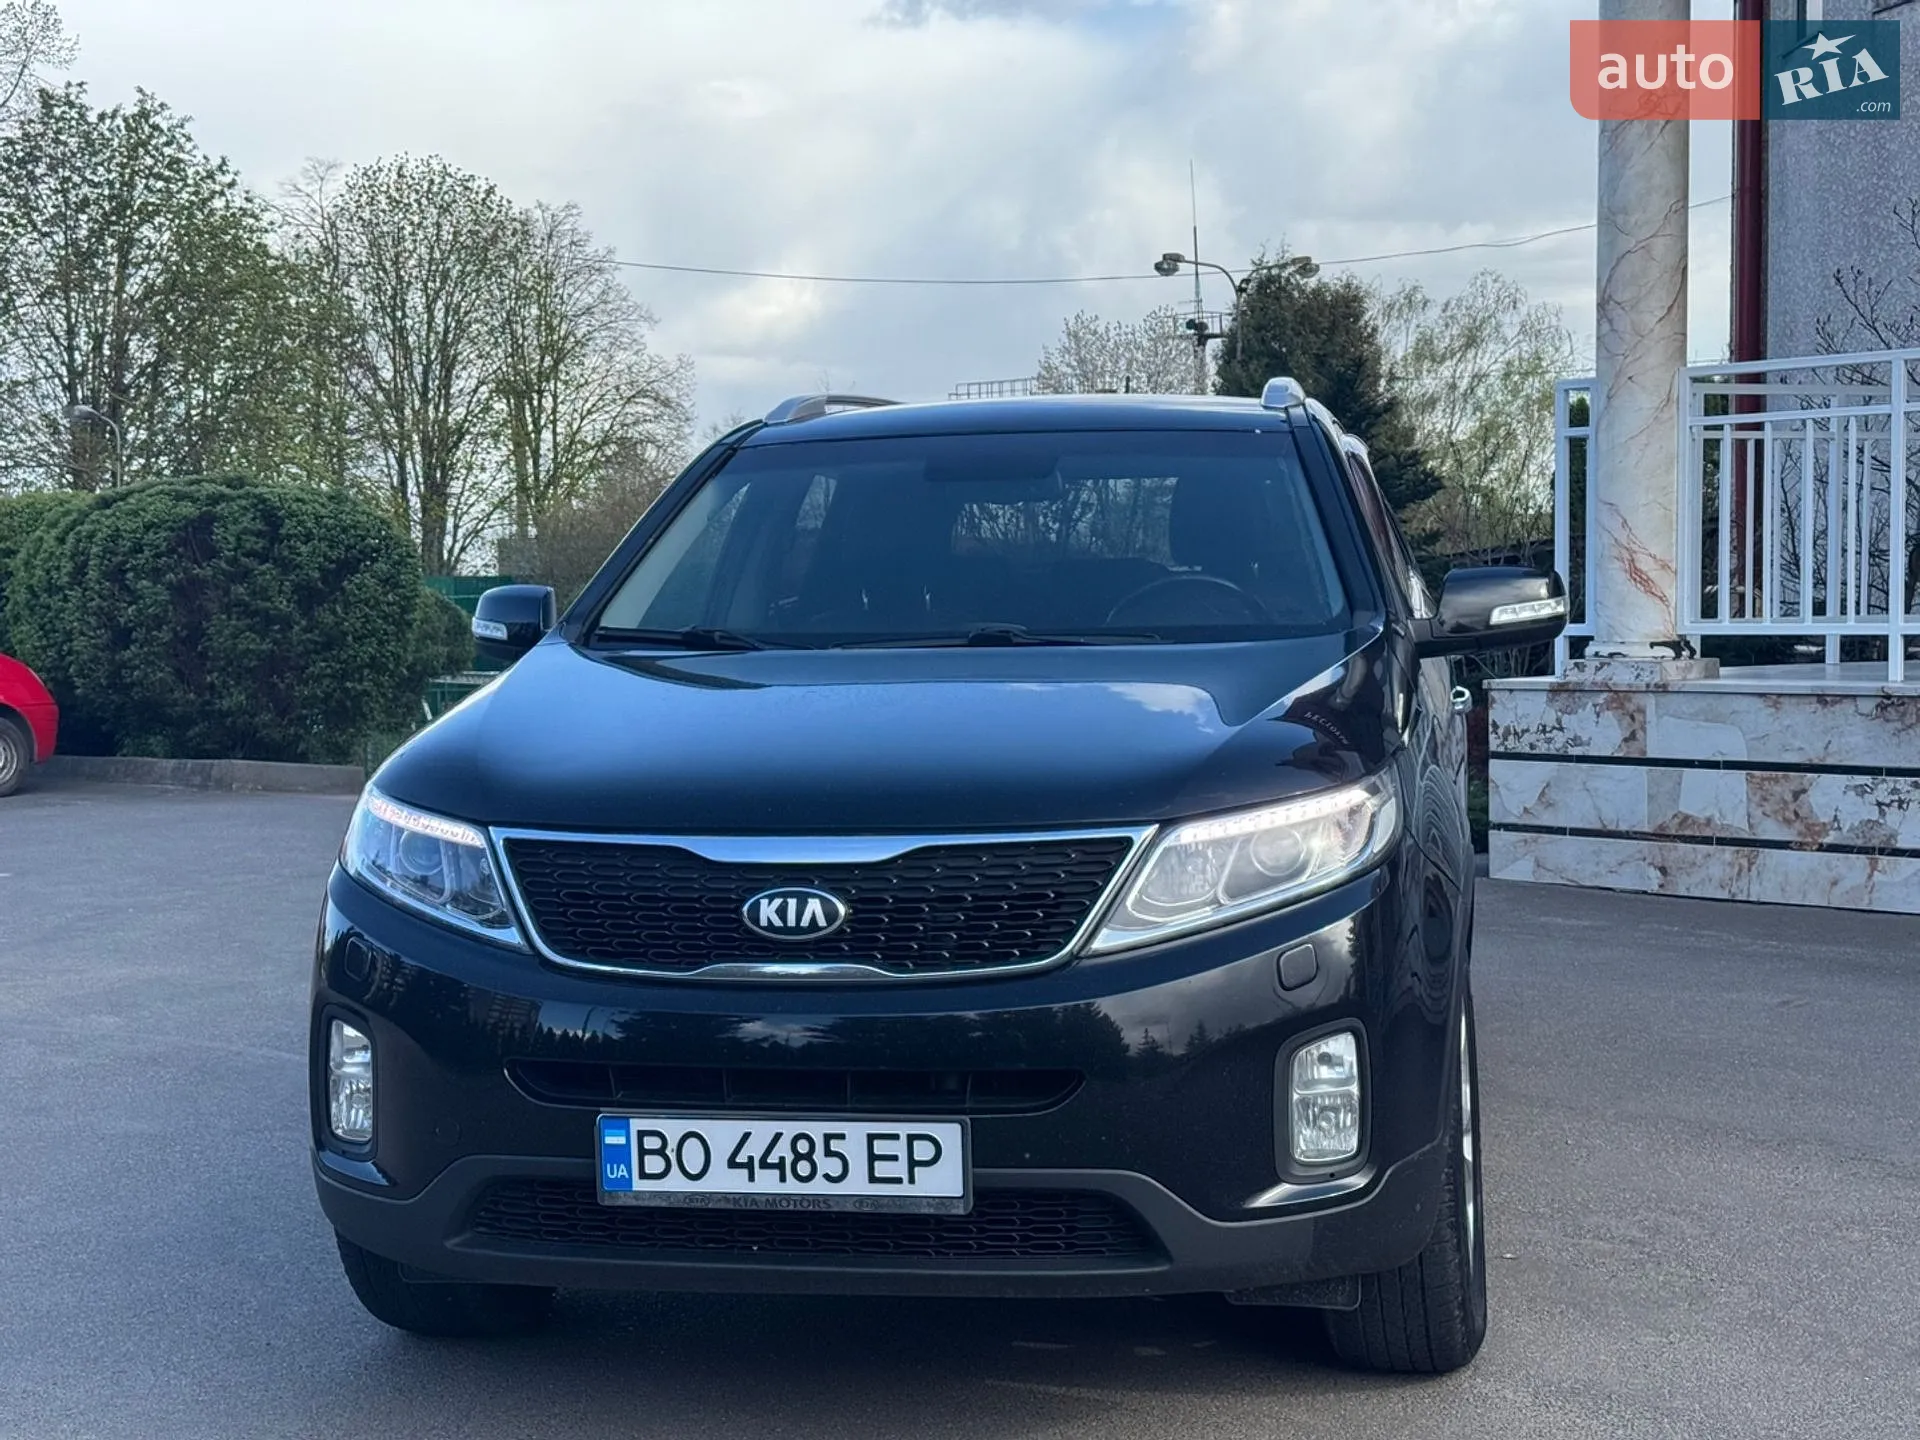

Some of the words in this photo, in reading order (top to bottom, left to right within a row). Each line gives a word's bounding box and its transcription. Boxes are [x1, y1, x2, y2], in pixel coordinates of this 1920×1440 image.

[759, 898, 828, 927] KIA
[637, 1130, 711, 1181] BO
[727, 1132, 849, 1183] 4485
[867, 1133, 942, 1184] EP
[606, 1163, 629, 1179] UA
[732, 1196, 760, 1208] KIA
[764, 1197, 832, 1209] MOTORS
